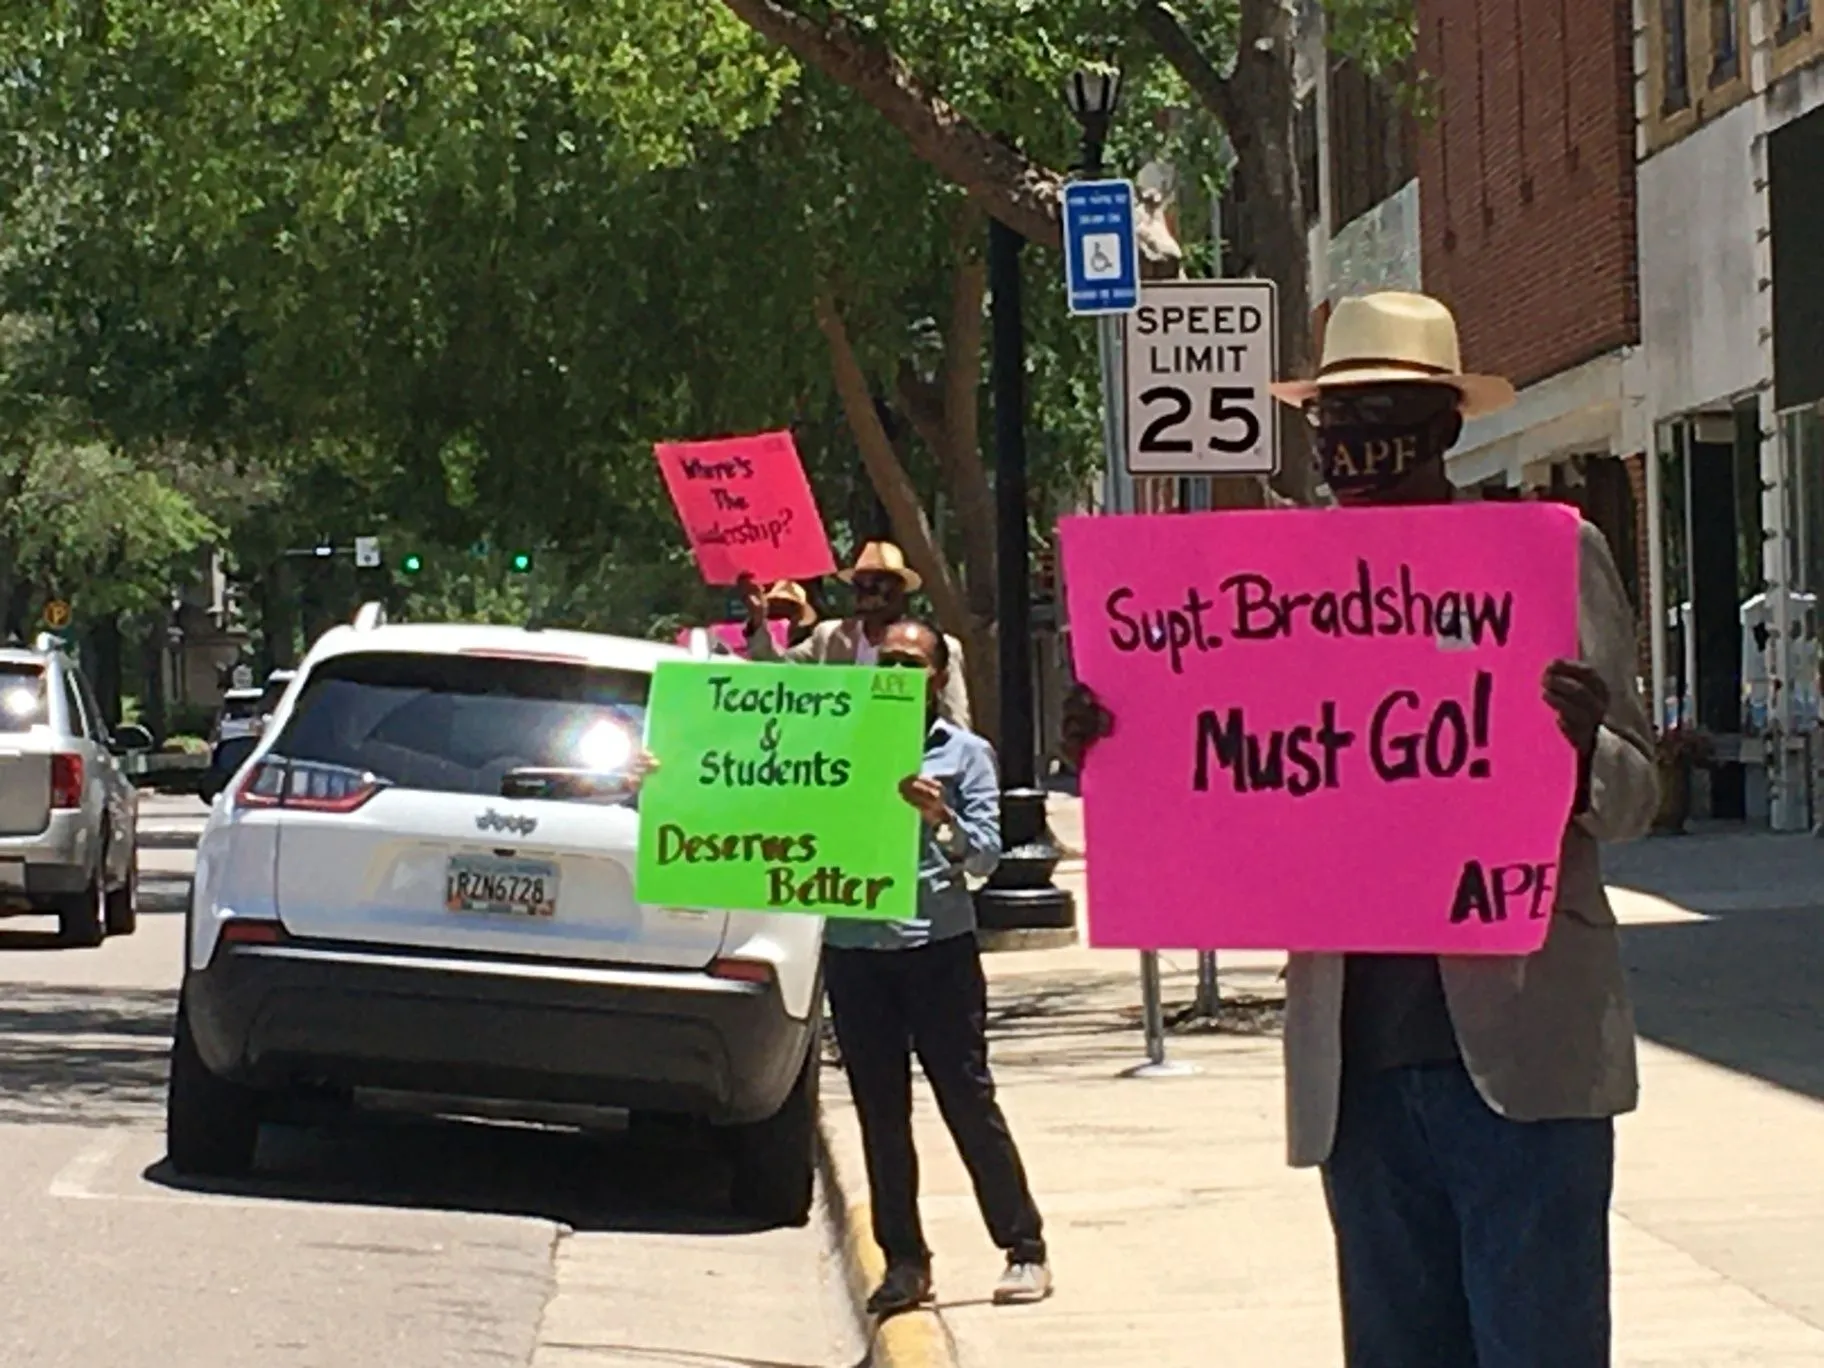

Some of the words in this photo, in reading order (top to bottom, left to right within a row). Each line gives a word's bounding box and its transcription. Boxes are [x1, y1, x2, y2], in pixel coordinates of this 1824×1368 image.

[1137, 306, 1262, 335] SPEED
[1150, 345, 1248, 374] LIMIT
[1138, 386, 1260, 454] 25
[679, 456, 754, 480] Where's
[709, 488, 750, 511] The
[692, 507, 793, 549] dership?
[1105, 586, 1223, 675] Supt.
[1219, 558, 1513, 647] Bradshaw
[708, 676, 852, 717] Teachers
[759, 717, 781, 752] &
[1193, 701, 1353, 796] Must
[1369, 670, 1493, 782] GO!
[699, 749, 852, 788] Students
[656, 824, 818, 865] Deserves
[765, 866, 895, 910] Better
[1450, 860, 1556, 924] APE
